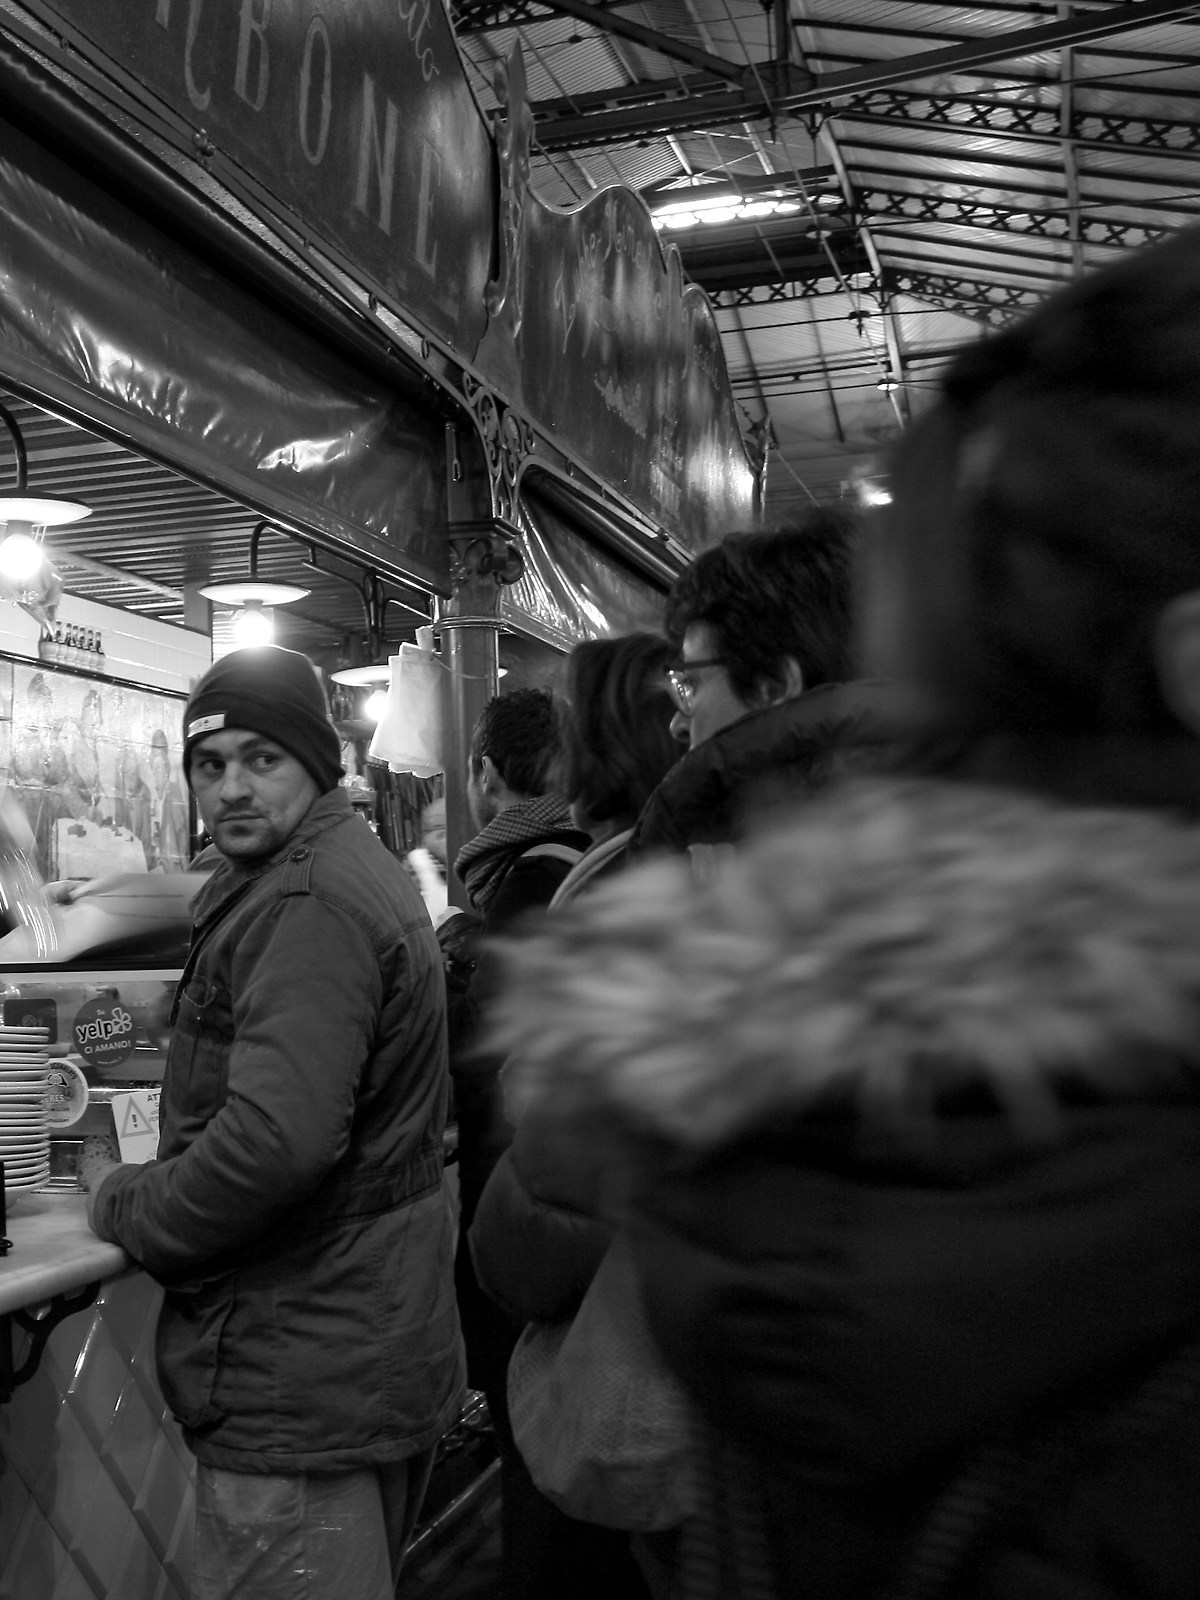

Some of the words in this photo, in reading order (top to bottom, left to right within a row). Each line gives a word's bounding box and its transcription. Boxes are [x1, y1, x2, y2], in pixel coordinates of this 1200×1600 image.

[75, 1018, 114, 1044] yelp
[84, 1046, 93, 1054] CI
[94, 1039, 131, 1053] AMANO!
